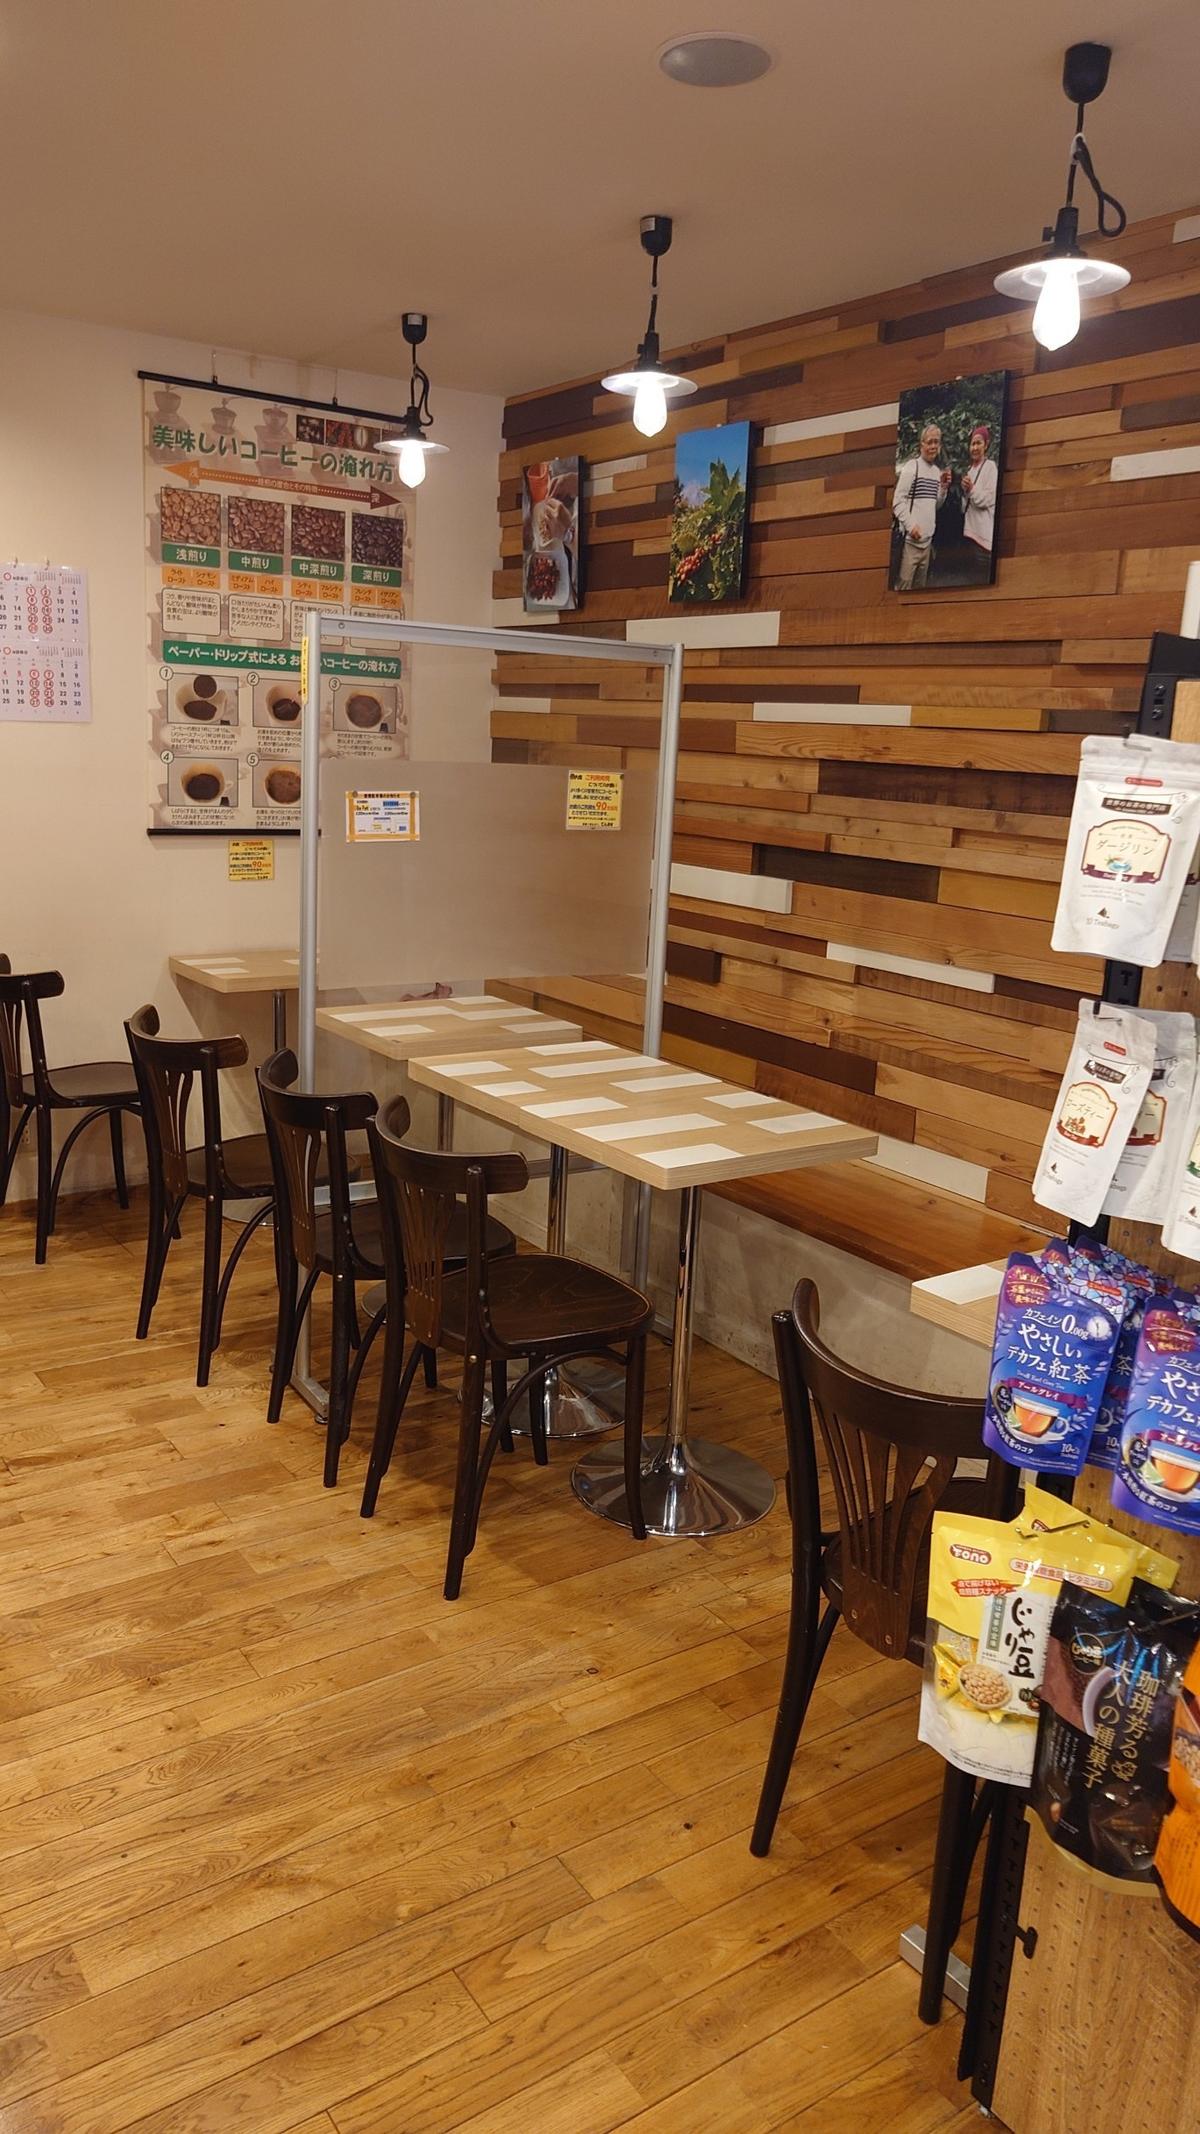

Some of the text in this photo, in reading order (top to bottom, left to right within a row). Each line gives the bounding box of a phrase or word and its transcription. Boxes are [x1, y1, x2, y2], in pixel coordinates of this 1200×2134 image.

[176, 548, 208, 563] 浅煎り
[241, 556, 270, 570] 中煎り
[299, 562, 338, 577] 中深煎り
[362, 569, 390, 582] 深煎り
[168, 645, 287, 666] ペーパー・ドリップ式による
[595, 801, 608, 811] 90
[1096, 839, 1154, 856] ダージリン
[1018, 1323, 1083, 1360] やさしい
[1007, 1345, 1092, 1385] デカフェ紅茶
[1018, 1381, 1061, 1401] アールグレイ
[1005, 1596, 1036, 1679] じゃり豆
[1081, 1659, 1135, 1790] 大人の種菓子
[1119, 1669, 1161, 1760] 珈琲芳る
